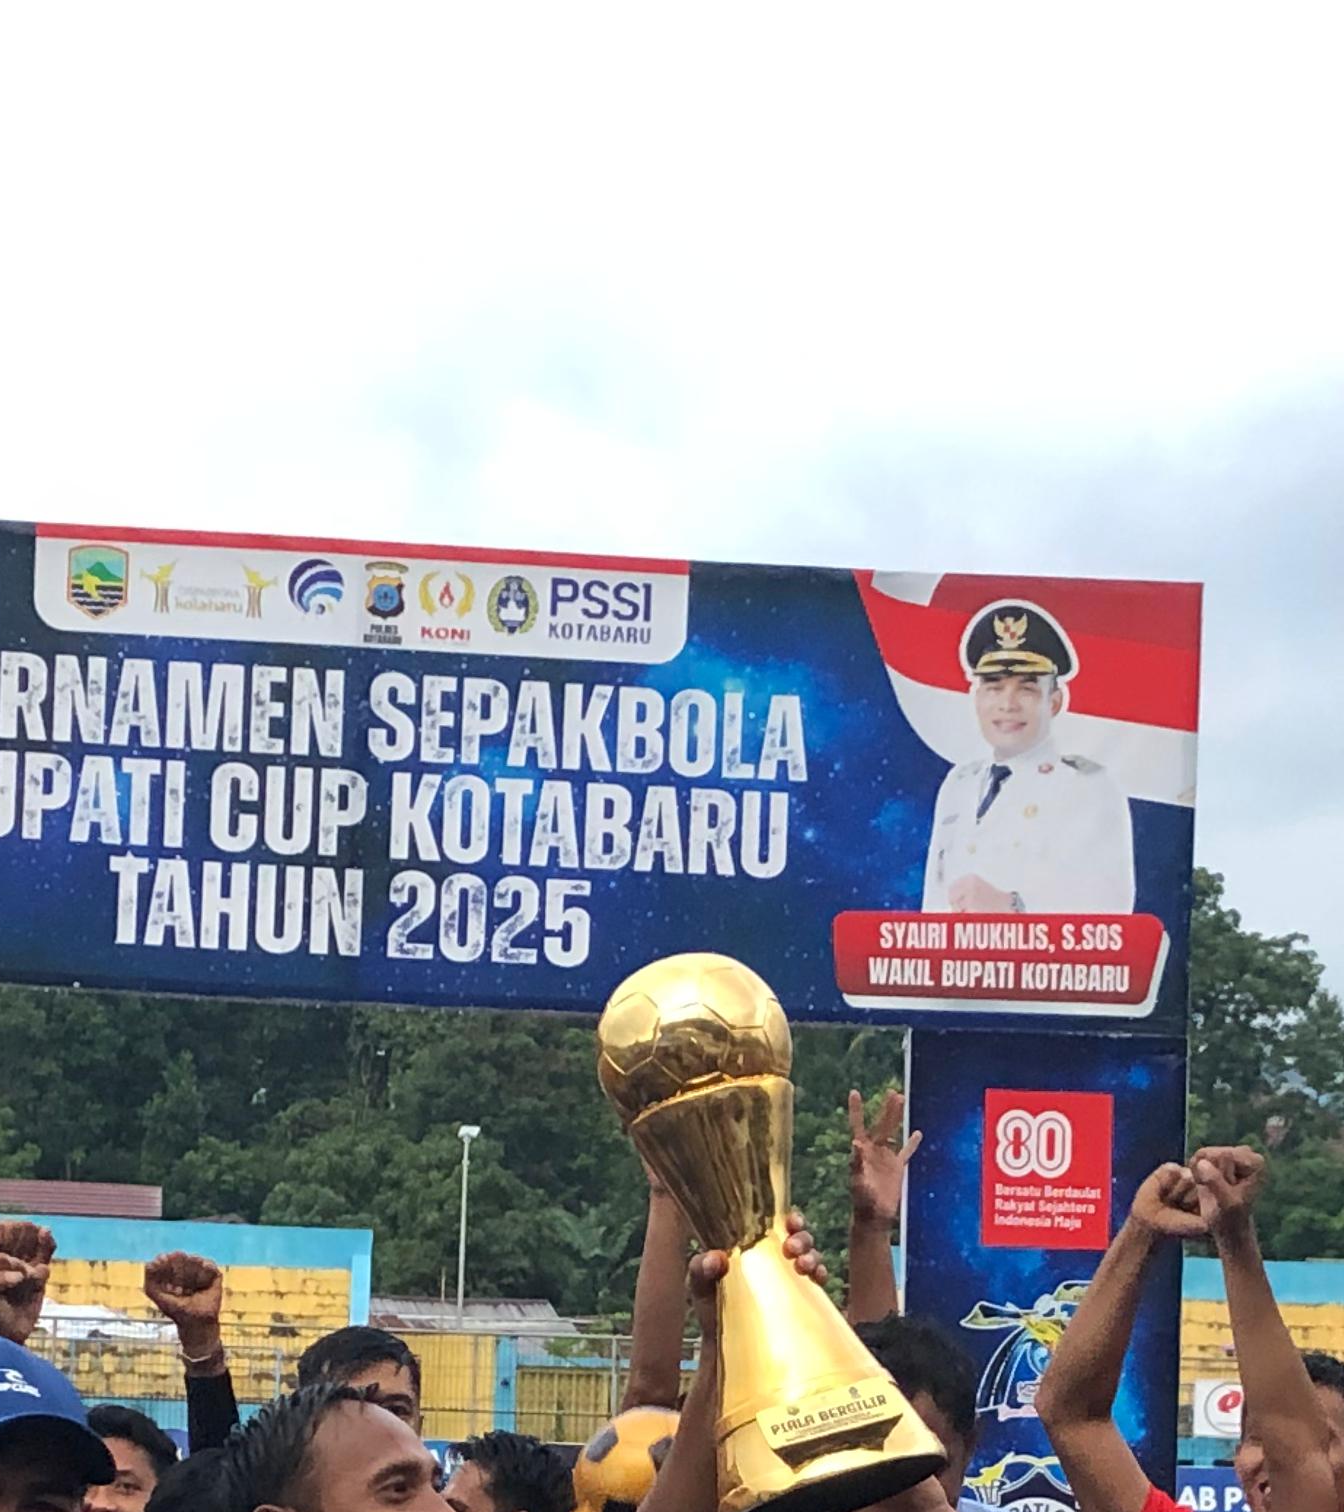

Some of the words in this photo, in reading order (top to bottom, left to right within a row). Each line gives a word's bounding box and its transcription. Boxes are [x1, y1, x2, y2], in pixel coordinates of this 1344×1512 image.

[550, 577, 651, 622] PSSI
[421, 627, 470, 640] KONI
[549, 623, 651, 644] KOTABARU
[367, 672, 807, 782] SEPAKBOLA
[210, 762, 365, 857] CUP
[390, 772, 789, 878] KOTABARU
[109, 853, 363, 957] TAHUN
[386, 870, 591, 967] 2025
[879, 921, 948, 950] SYAIRI
[955, 923, 1054, 954] MUKHLIS,
[1061, 924, 1123, 952] S.SOS
[869, 958, 934, 986] WAKIL
[941, 959, 1015, 990] BUPATI
[1021, 962, 1129, 993] KOTABARU
[996, 1109, 1072, 1178] 80
[994, 1198, 1035, 1213] Rakyat
[995, 1183, 1042, 1197] Bersatu
[1044, 1185, 1102, 1199] Berdaulat
[771, 1414, 816, 1436] PIALA
[818, 1394, 888, 1422] BERGILIR
